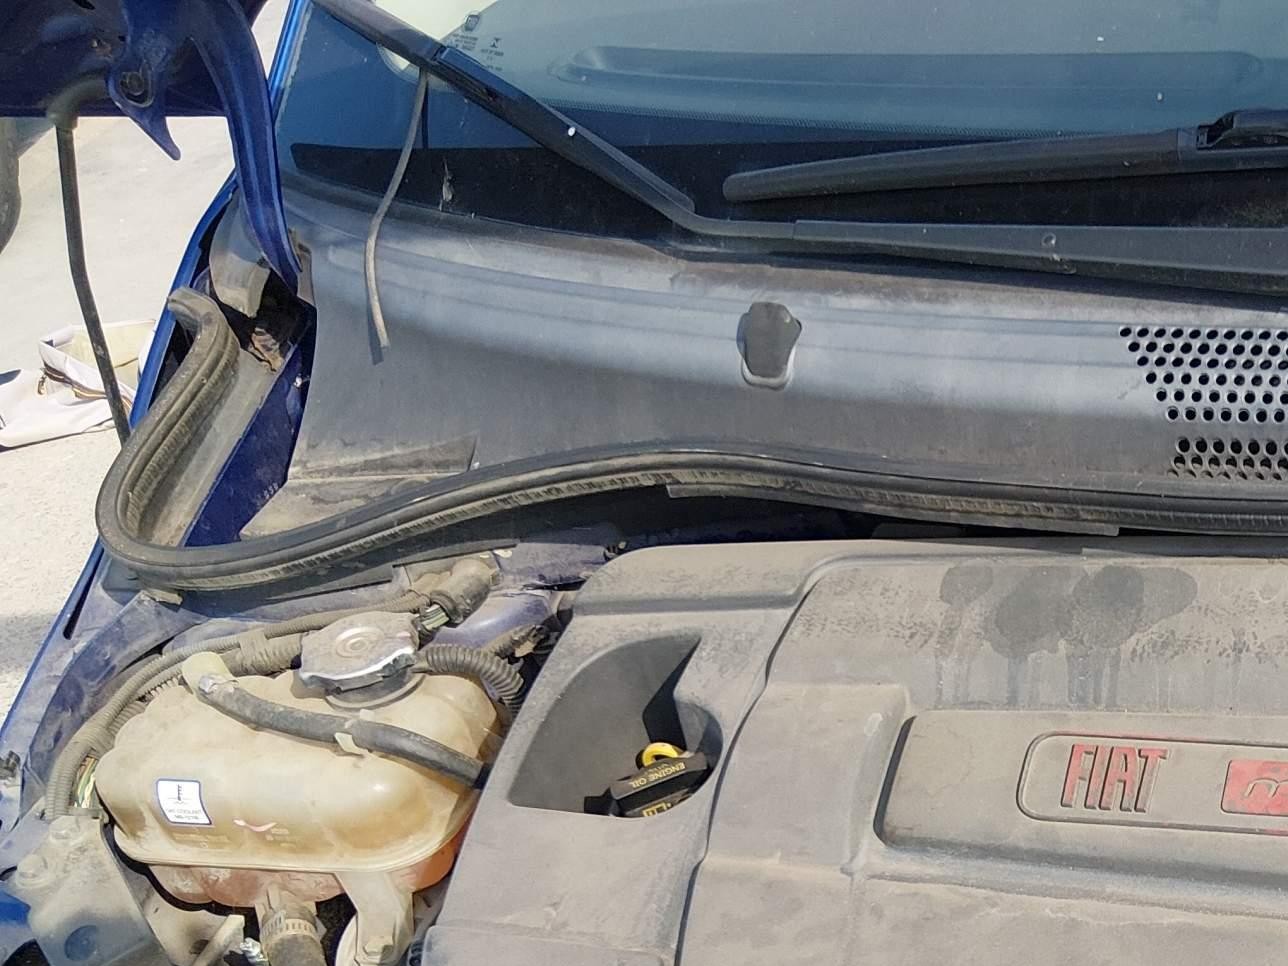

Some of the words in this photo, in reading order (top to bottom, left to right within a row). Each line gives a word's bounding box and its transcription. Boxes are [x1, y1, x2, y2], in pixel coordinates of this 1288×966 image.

[648, 762, 685, 781] ENGINE
[1060, 744, 1169, 813] FIAT
[629, 778, 646, 788] OIL
